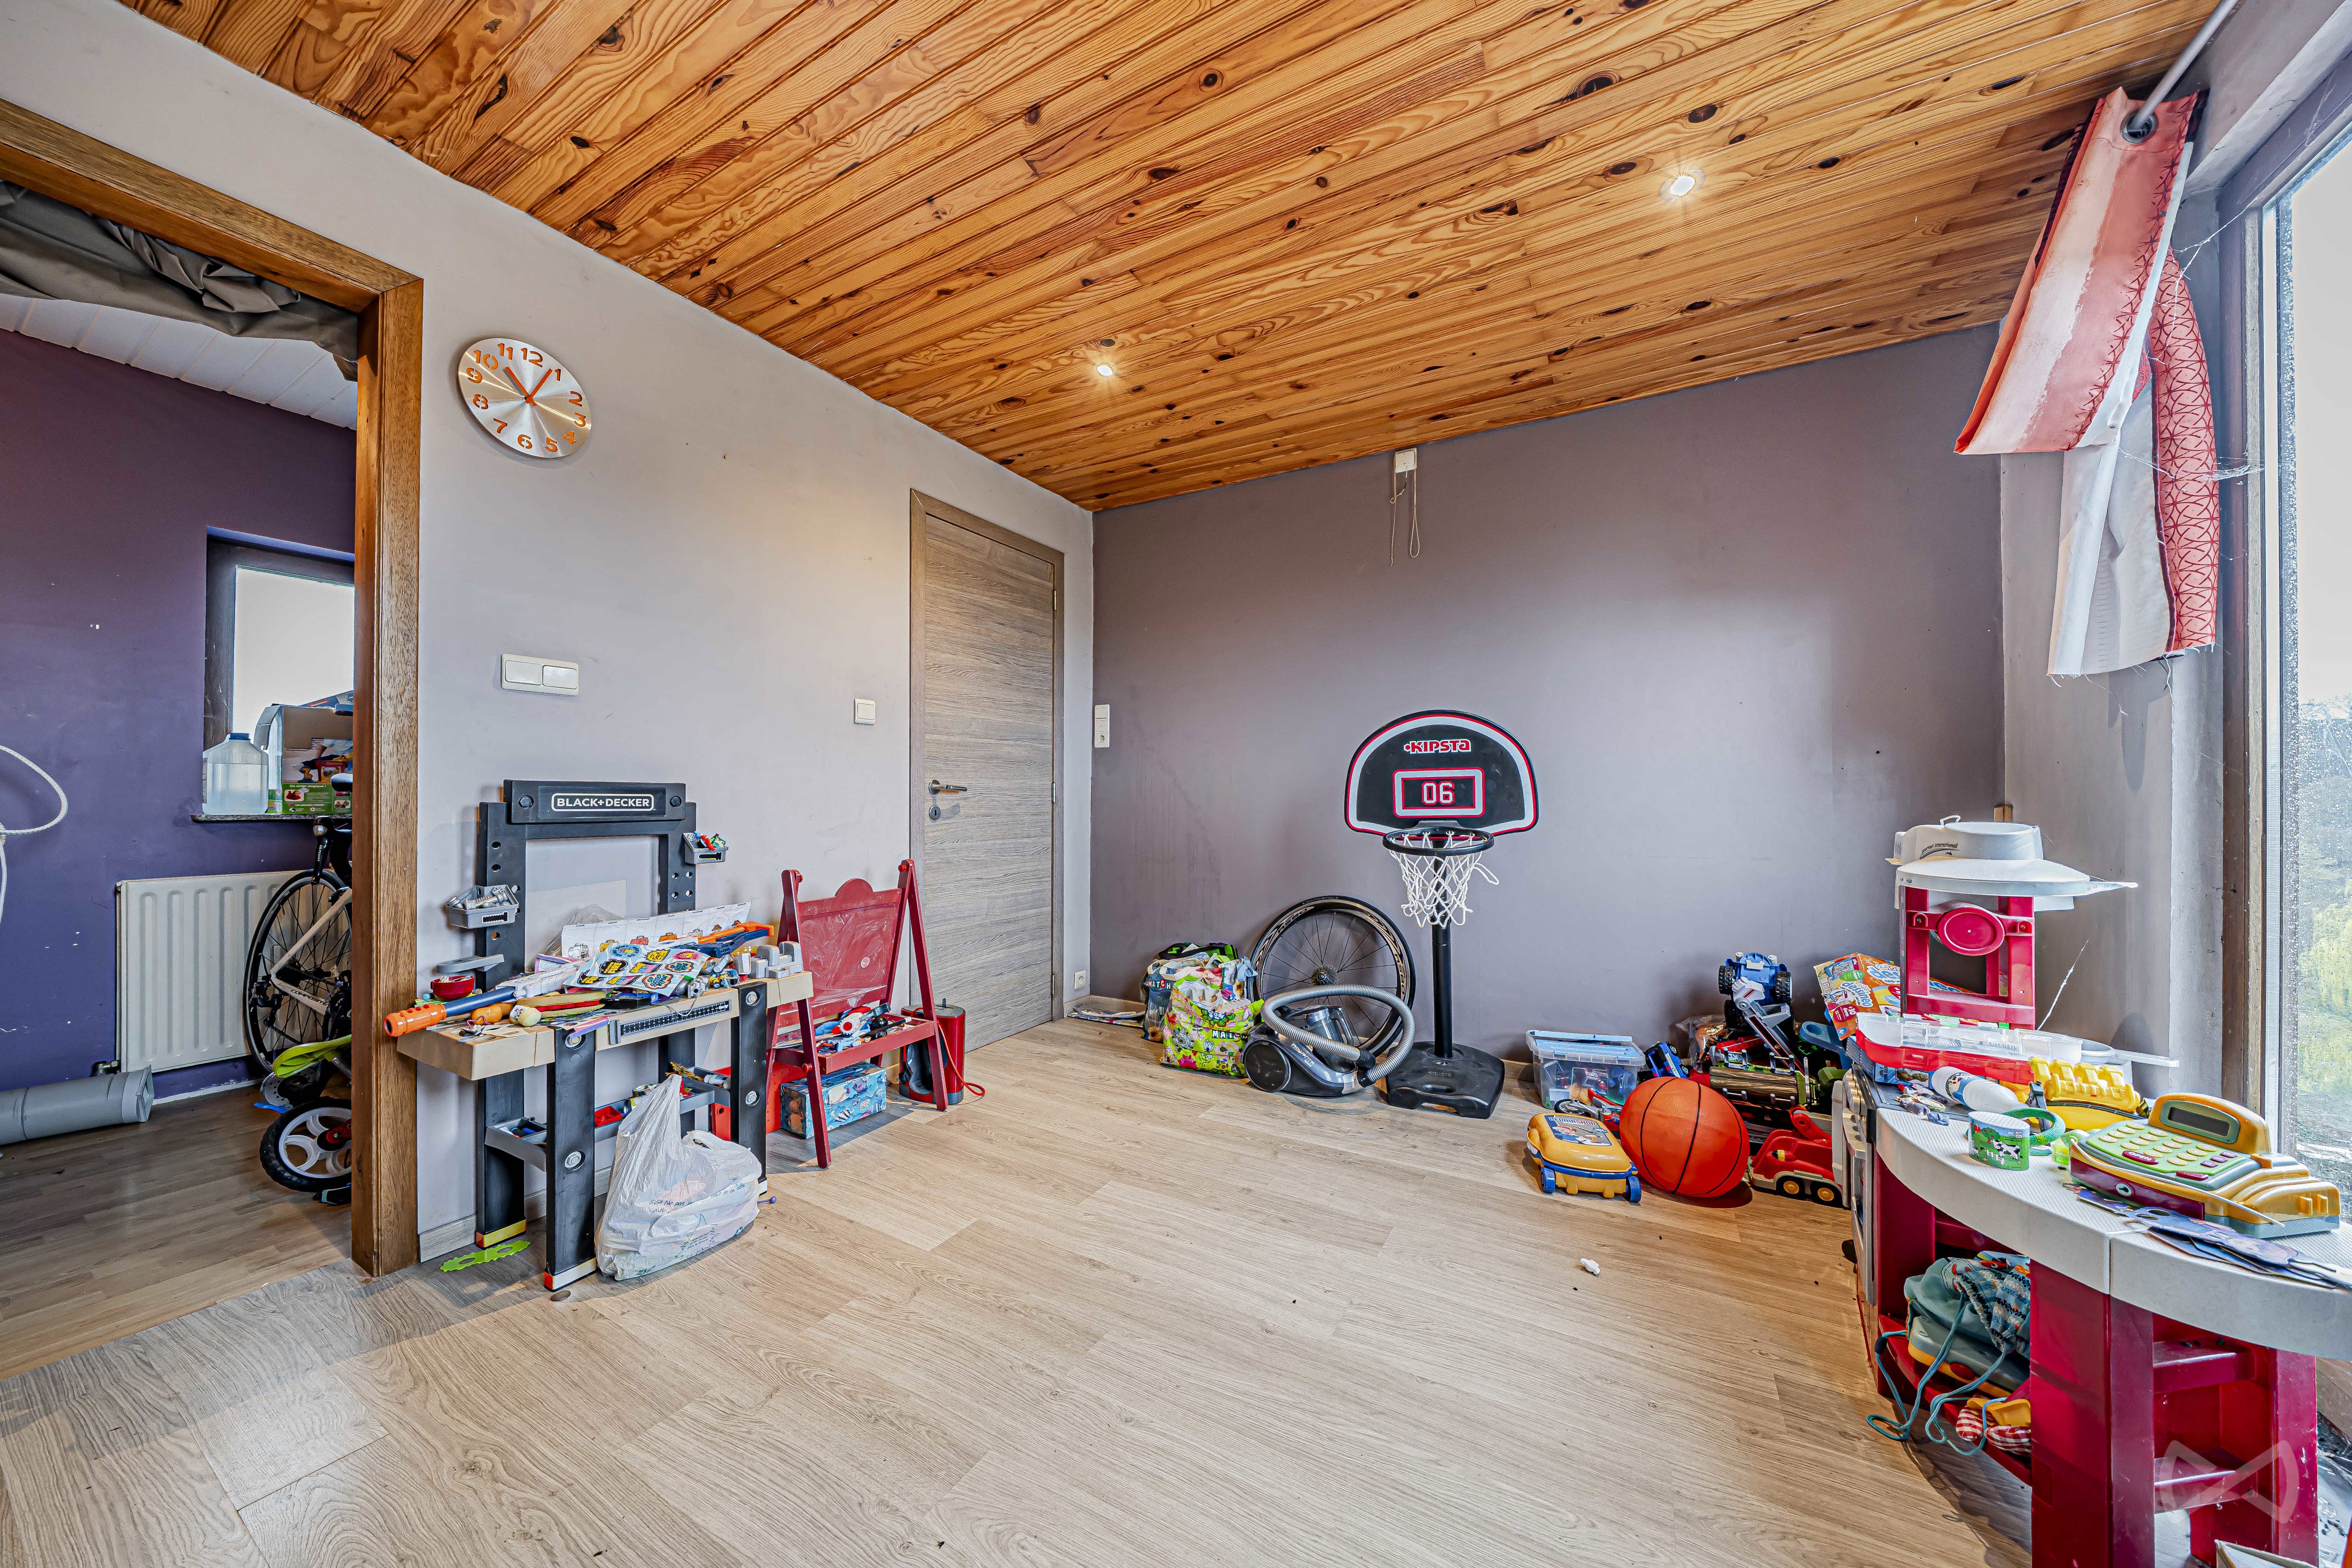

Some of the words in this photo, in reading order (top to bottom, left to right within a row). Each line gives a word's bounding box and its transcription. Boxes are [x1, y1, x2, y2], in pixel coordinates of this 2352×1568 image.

[473, 350, 498, 370] 10
[498, 343, 513, 361] 11
[520, 347, 543, 368] 12
[466, 368, 483, 384] 9
[554, 368, 561, 382] 1
[472, 394, 489, 410] 8
[568, 391, 582, 407] 2
[493, 418, 508, 434] 7
[573, 412, 586, 428] 3
[517, 434, 533, 449] 6
[544, 437, 558, 453] 5
[562, 430, 577, 444] 4
[1409, 739, 1472, 754] KIPSTA
[1421, 781, 1455, 805] 06
[556, 798, 650, 807] BLACK+DECKER
[1848, 1005, 1856, 1016] +30
[2128, 1151, 2152, 1161] OPEN
